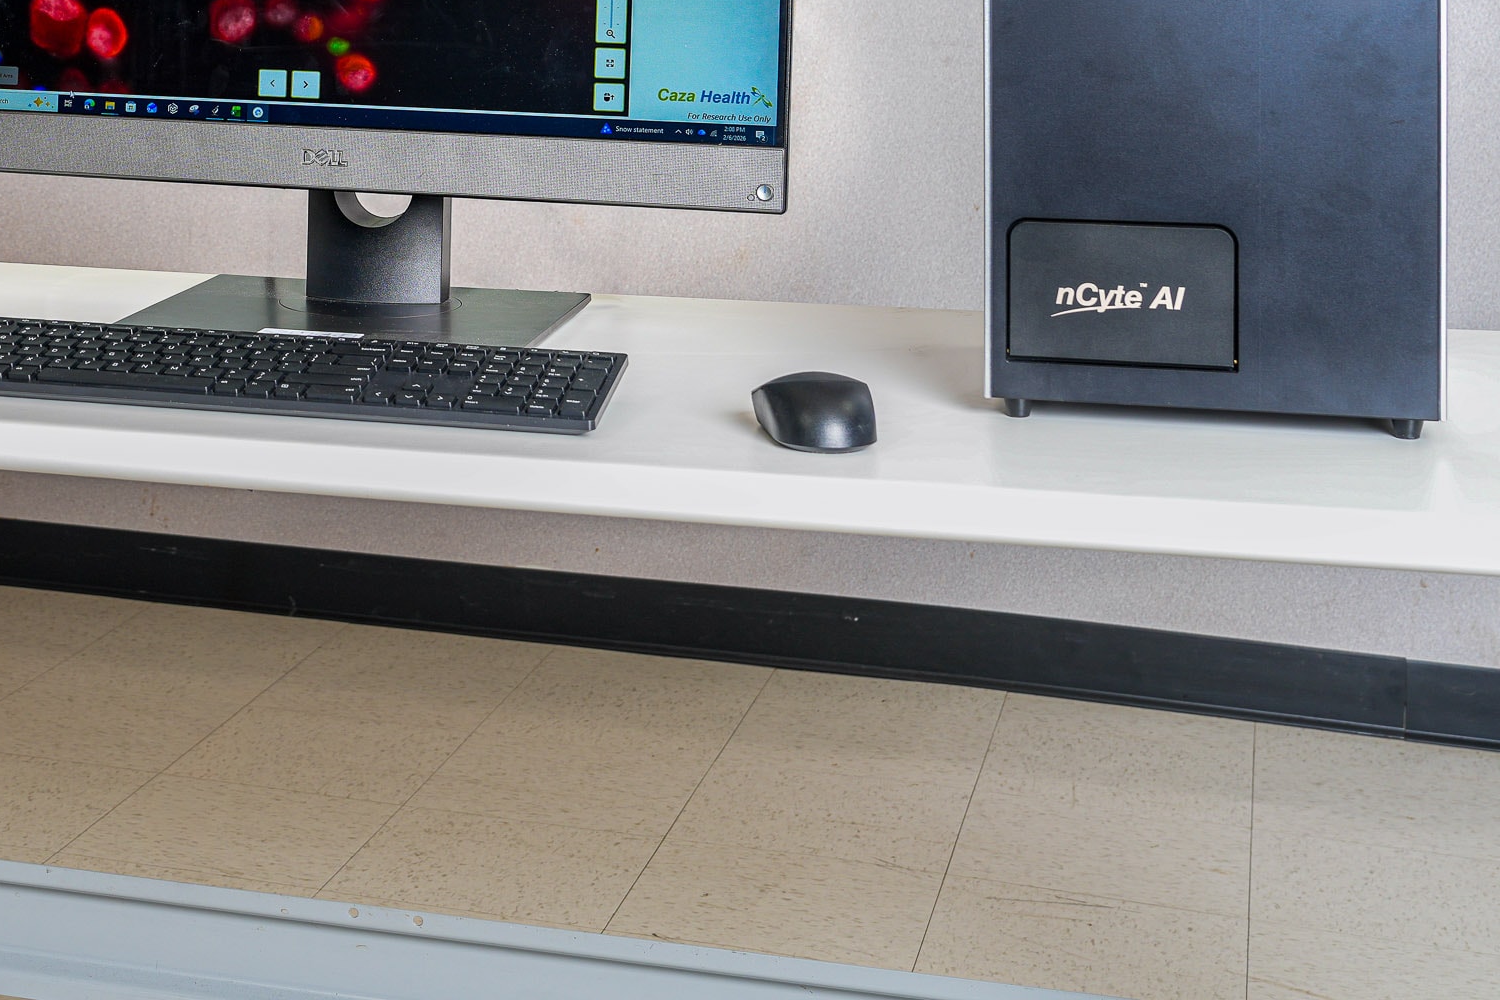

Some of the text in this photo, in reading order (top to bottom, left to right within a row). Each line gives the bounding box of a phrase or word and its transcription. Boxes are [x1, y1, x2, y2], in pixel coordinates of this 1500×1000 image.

[658, 88, 751, 104] Caza Health
[702, 113, 736, 121] Research
[753, 116, 771, 124] Only
[302, 149, 348, 167] DELL
[1149, 286, 1186, 311] AI
